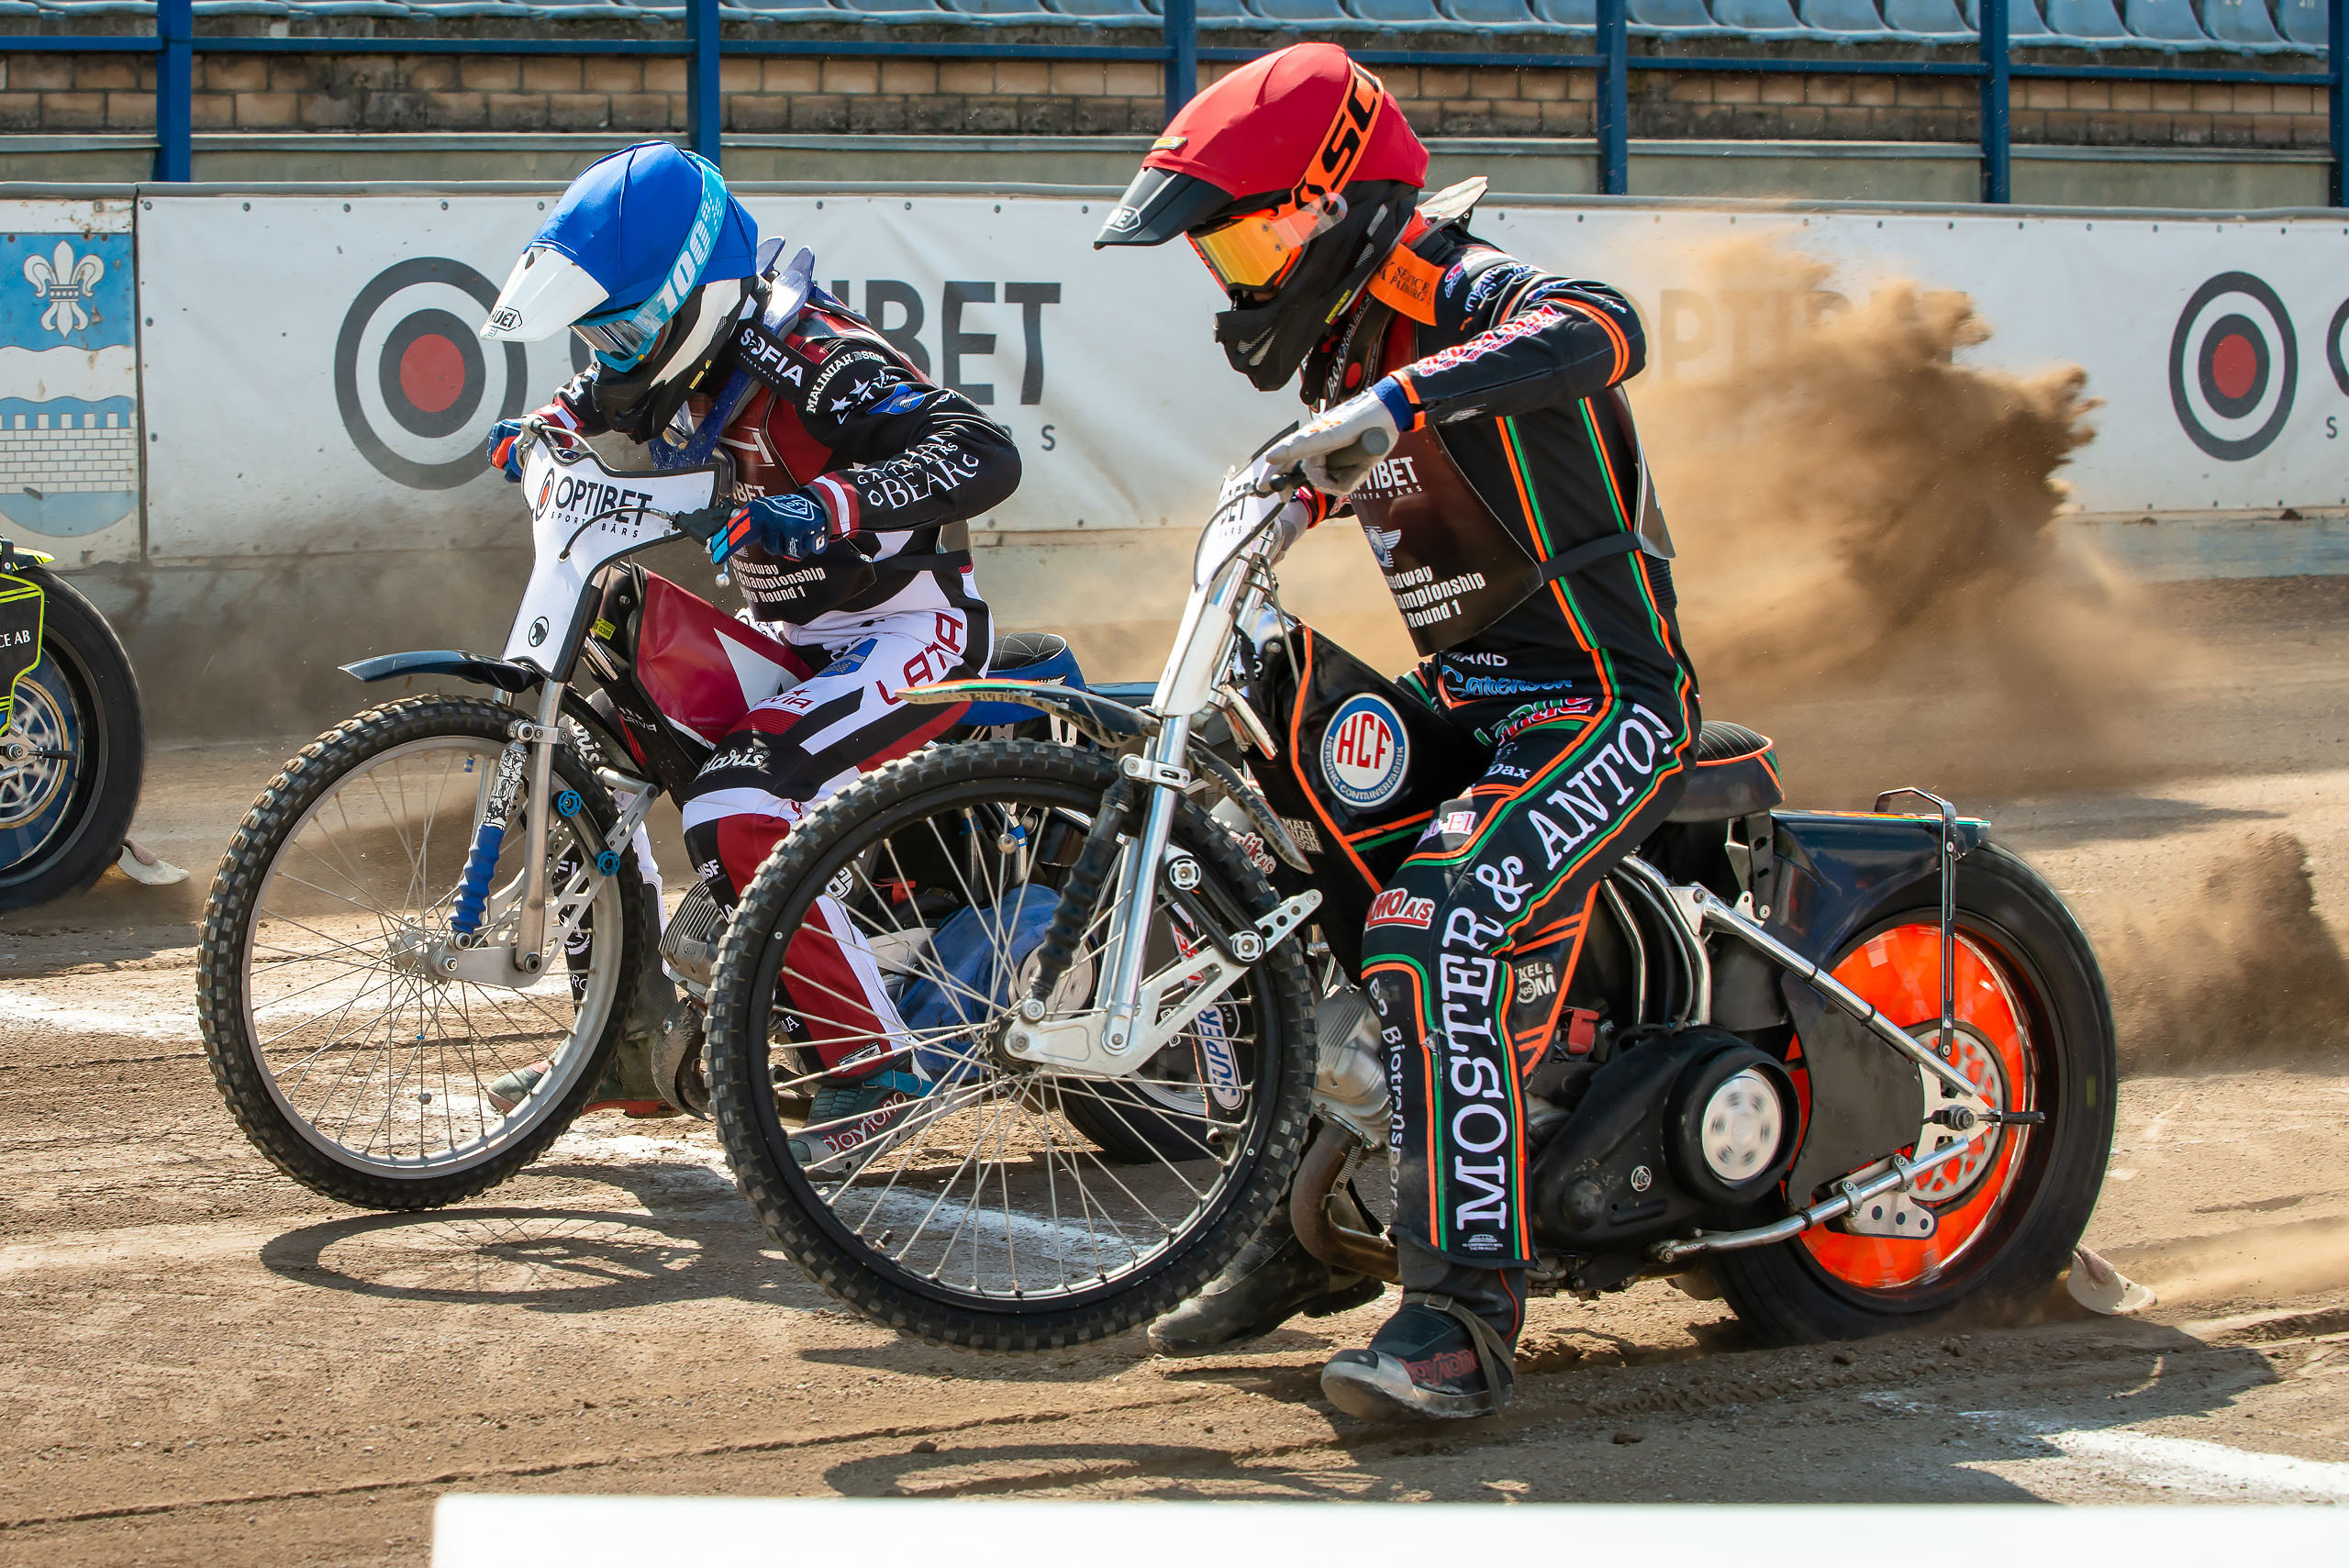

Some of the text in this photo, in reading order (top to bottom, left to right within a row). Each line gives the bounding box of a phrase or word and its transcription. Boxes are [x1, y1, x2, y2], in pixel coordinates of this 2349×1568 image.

[806, 353, 854, 414] MALINIAK
[555, 475, 653, 527] OPTIBET
[761, 587, 797, 604] Round
[797, 585, 806, 597] 1
[1407, 599, 1462, 628] Round 1
[15, 629, 31, 645] AB
[1336, 713, 1393, 770] HCF
[1436, 906, 1508, 1230] MOSTER
[1475, 855, 1533, 913] &
[1528, 704, 1674, 871] ANTO!
